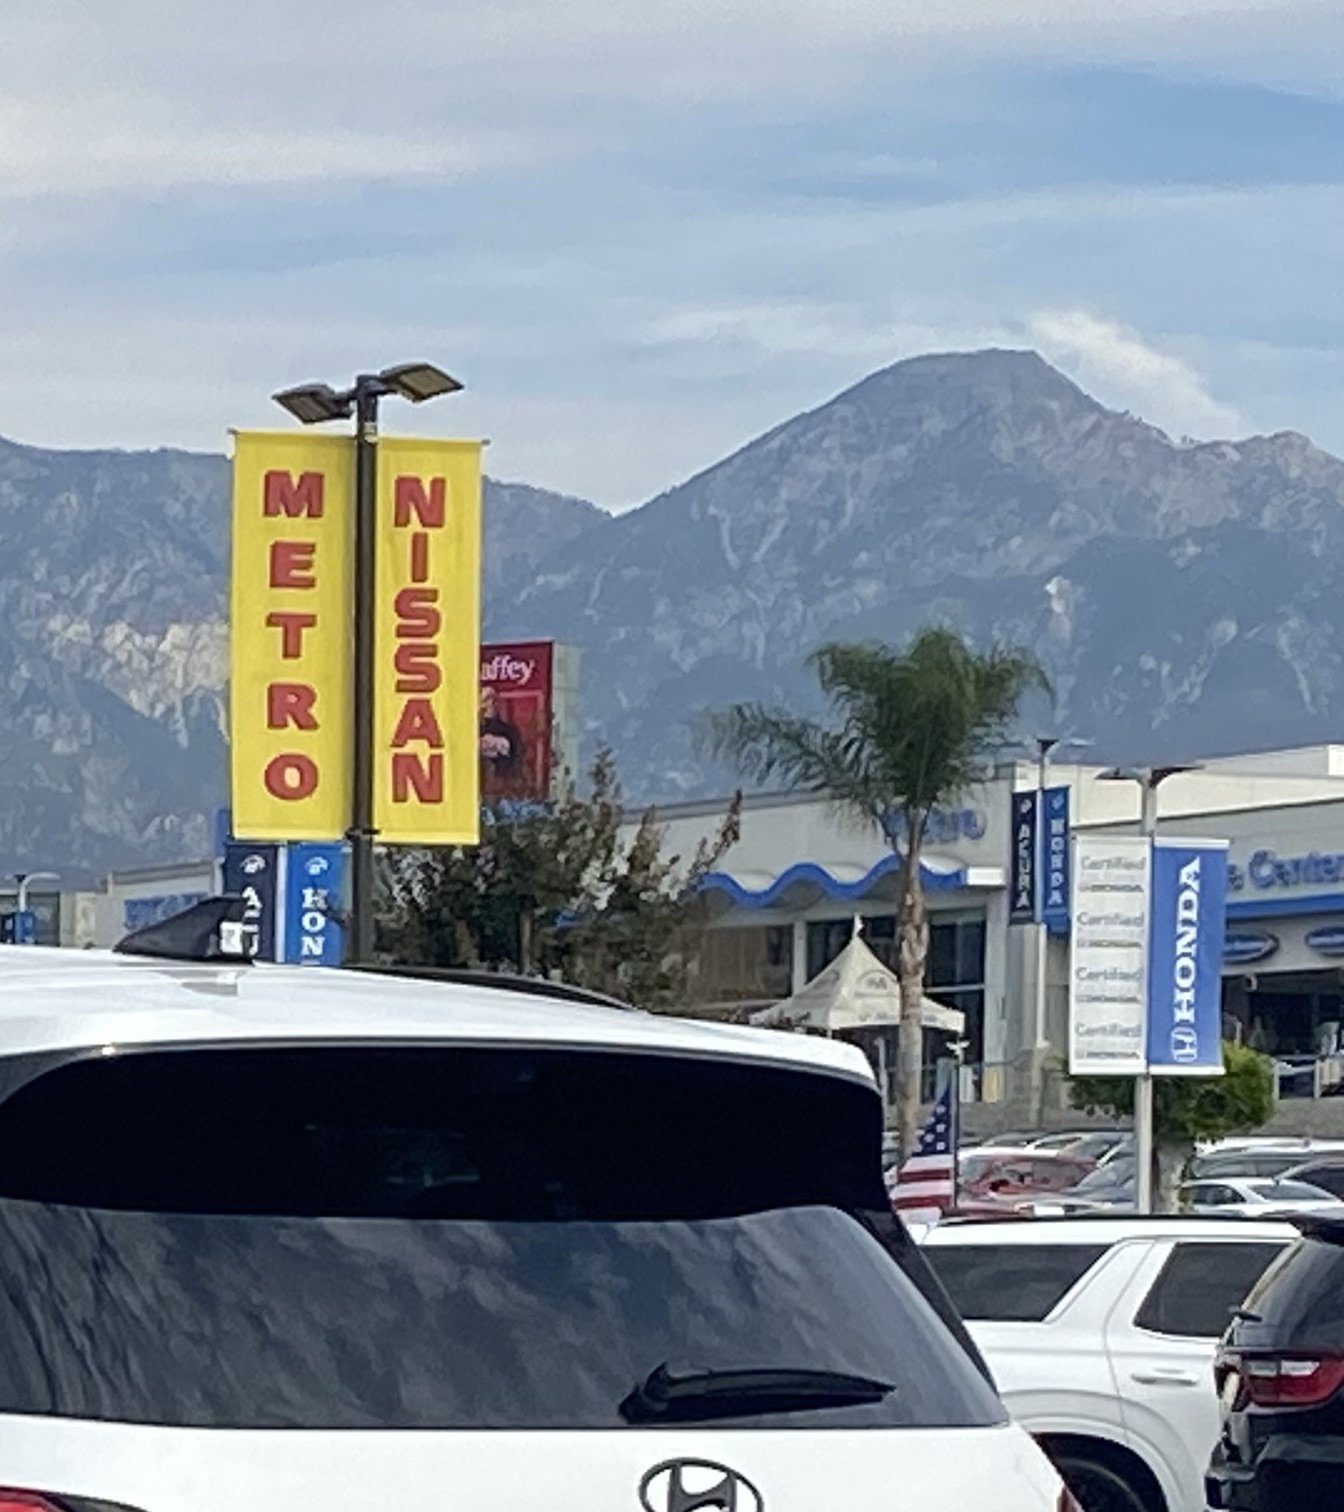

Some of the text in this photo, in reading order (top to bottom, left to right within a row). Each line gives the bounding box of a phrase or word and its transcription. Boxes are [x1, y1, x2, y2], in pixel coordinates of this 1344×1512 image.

[263, 470, 325, 802] METRO
[389, 475, 447, 804] NISSAN
[302, 887, 328, 965] HON
[1174, 856, 1200, 1023] HONDA
